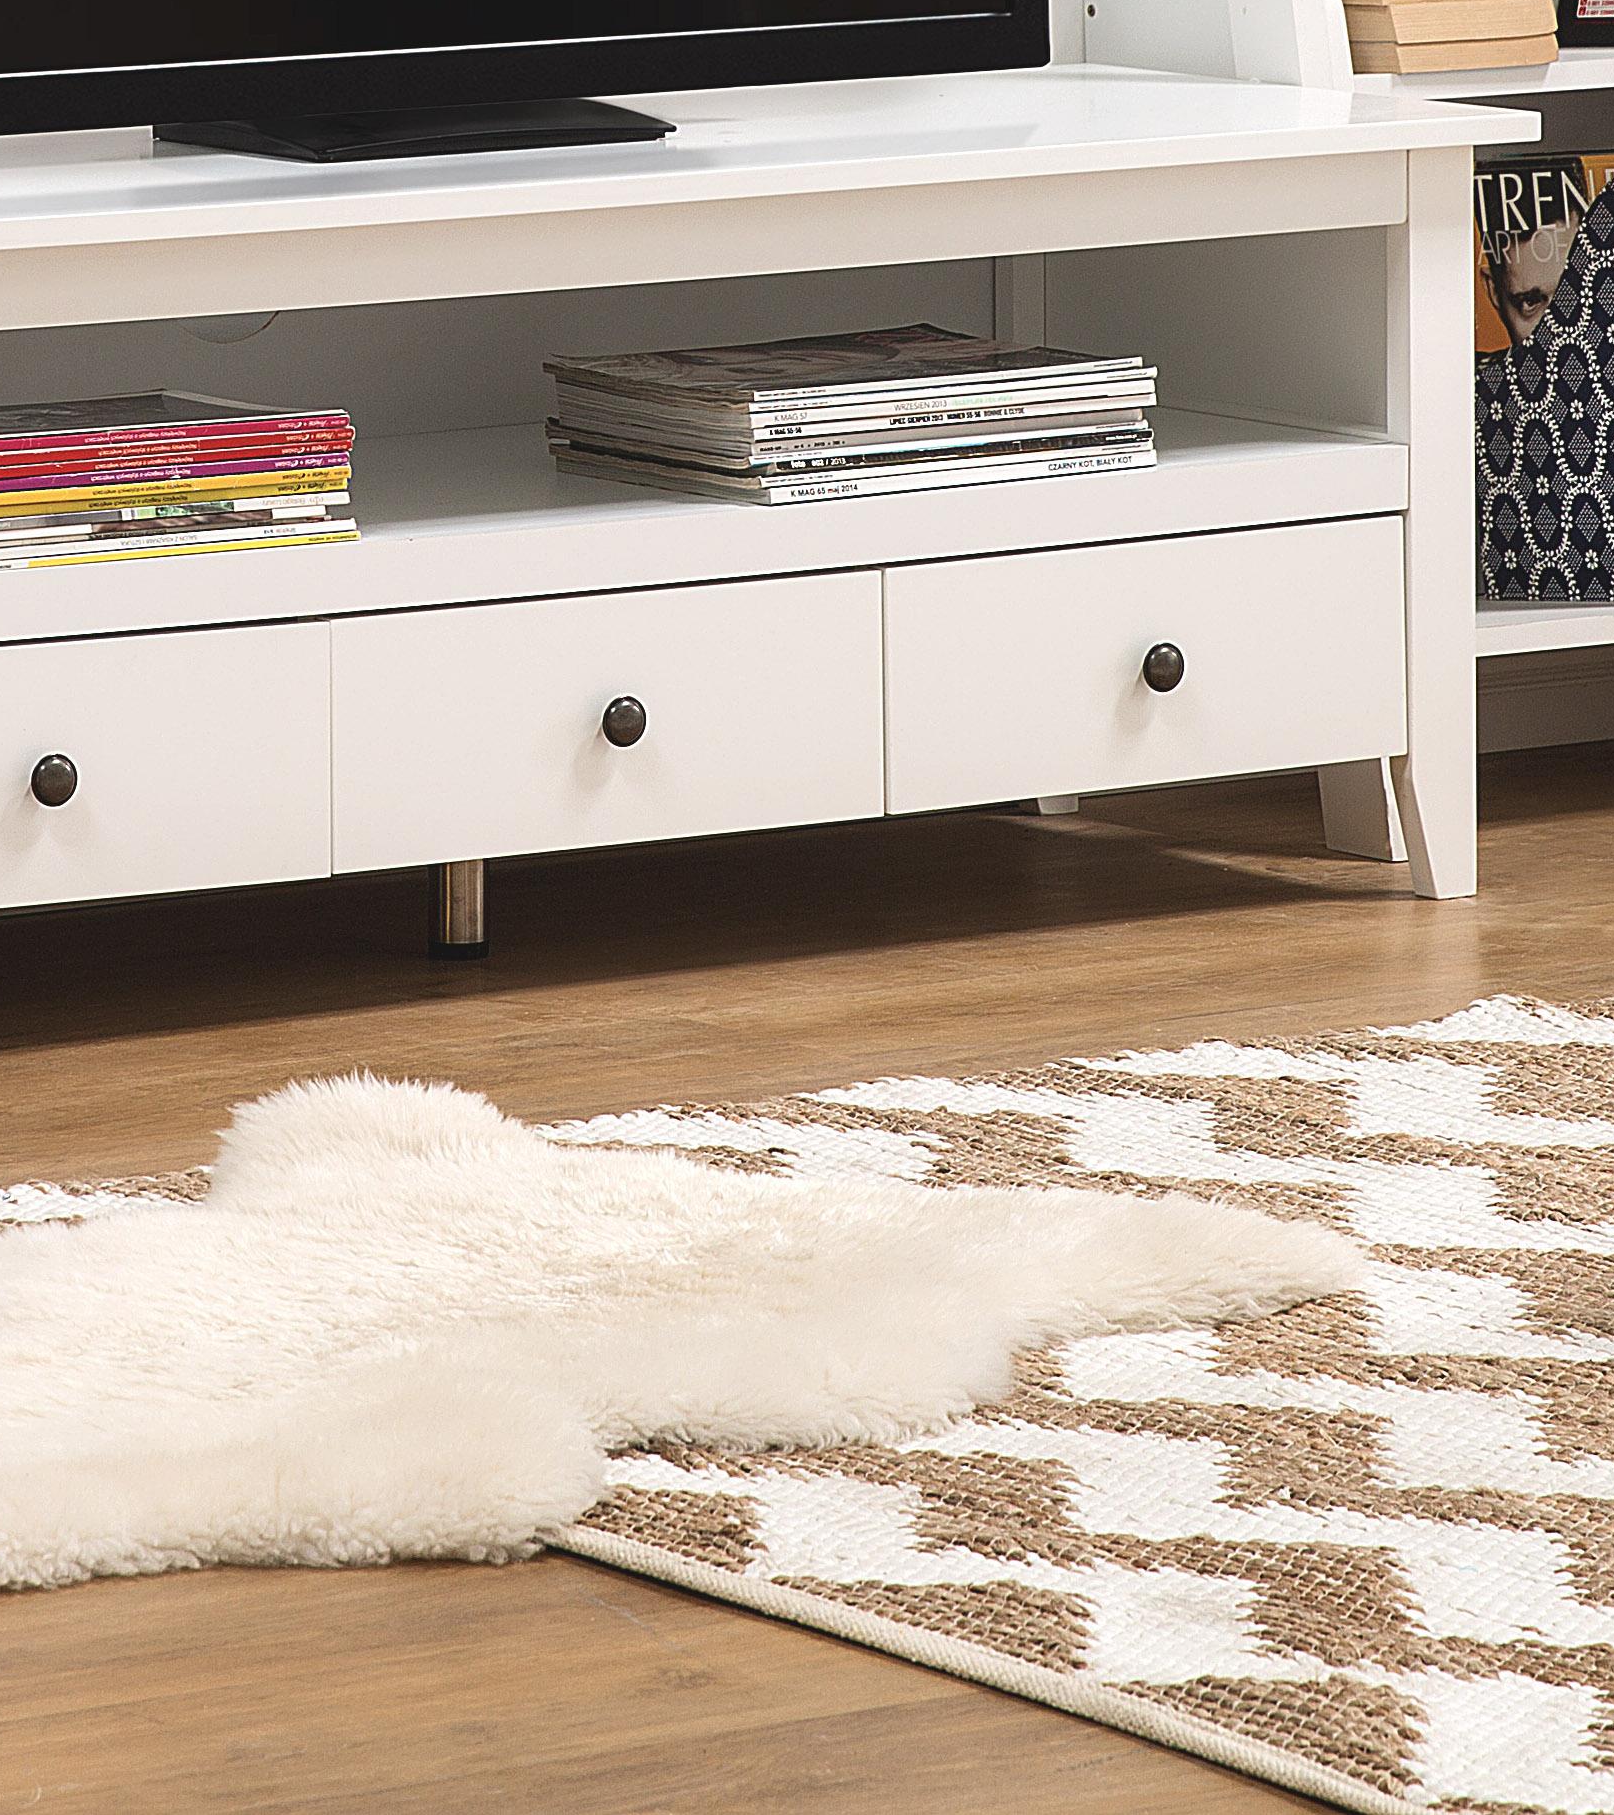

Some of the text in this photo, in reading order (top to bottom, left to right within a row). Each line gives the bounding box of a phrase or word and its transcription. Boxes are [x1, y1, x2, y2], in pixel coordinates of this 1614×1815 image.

[1477, 229, 1522, 265] ART
[932, 399, 947, 409] 2013
[1048, 461, 1077, 471] CZARNY
[1078, 459, 1094, 469] KOT,
[1118, 455, 1132, 464] KOT
[797, 487, 815, 496] MAG
[817, 486, 825, 494] 65
[827, 486, 840, 494] maj
[841, 484, 858, 492] 2014
